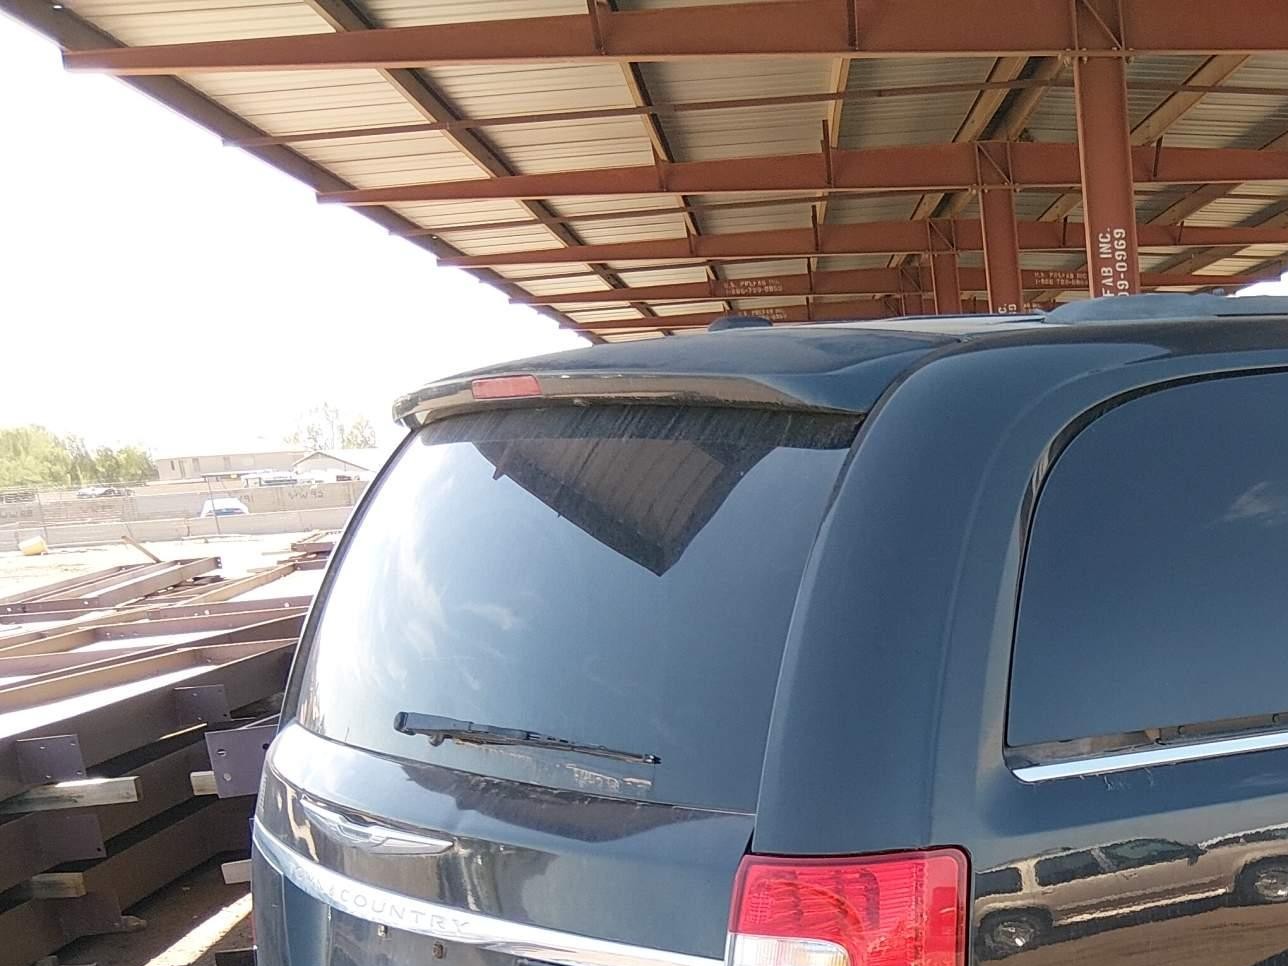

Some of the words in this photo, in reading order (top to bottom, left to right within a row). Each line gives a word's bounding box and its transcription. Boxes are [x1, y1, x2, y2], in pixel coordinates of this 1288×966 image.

[1098, 227, 1113, 258] INC.
[1113, 228, 1129, 297] 9-0969
[1101, 267, 1115, 297] FAB
[340, 889, 471, 934] COUNTRY
